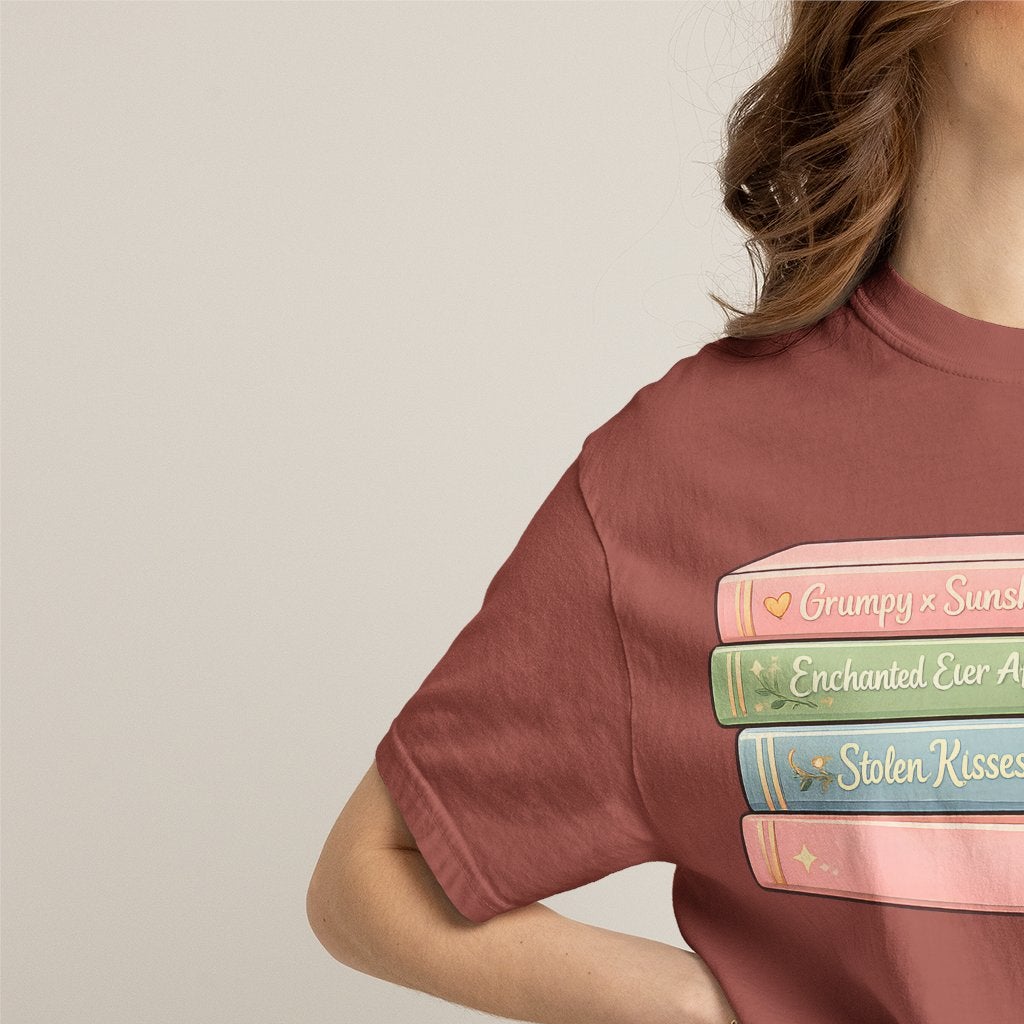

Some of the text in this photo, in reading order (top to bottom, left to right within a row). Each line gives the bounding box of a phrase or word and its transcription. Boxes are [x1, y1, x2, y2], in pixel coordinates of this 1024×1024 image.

[799, 582, 913, 628] Grumpy
[919, 592, 936, 612] x
[789, 655, 928, 698] Enchanted
[837, 742, 931, 791] Stolen
